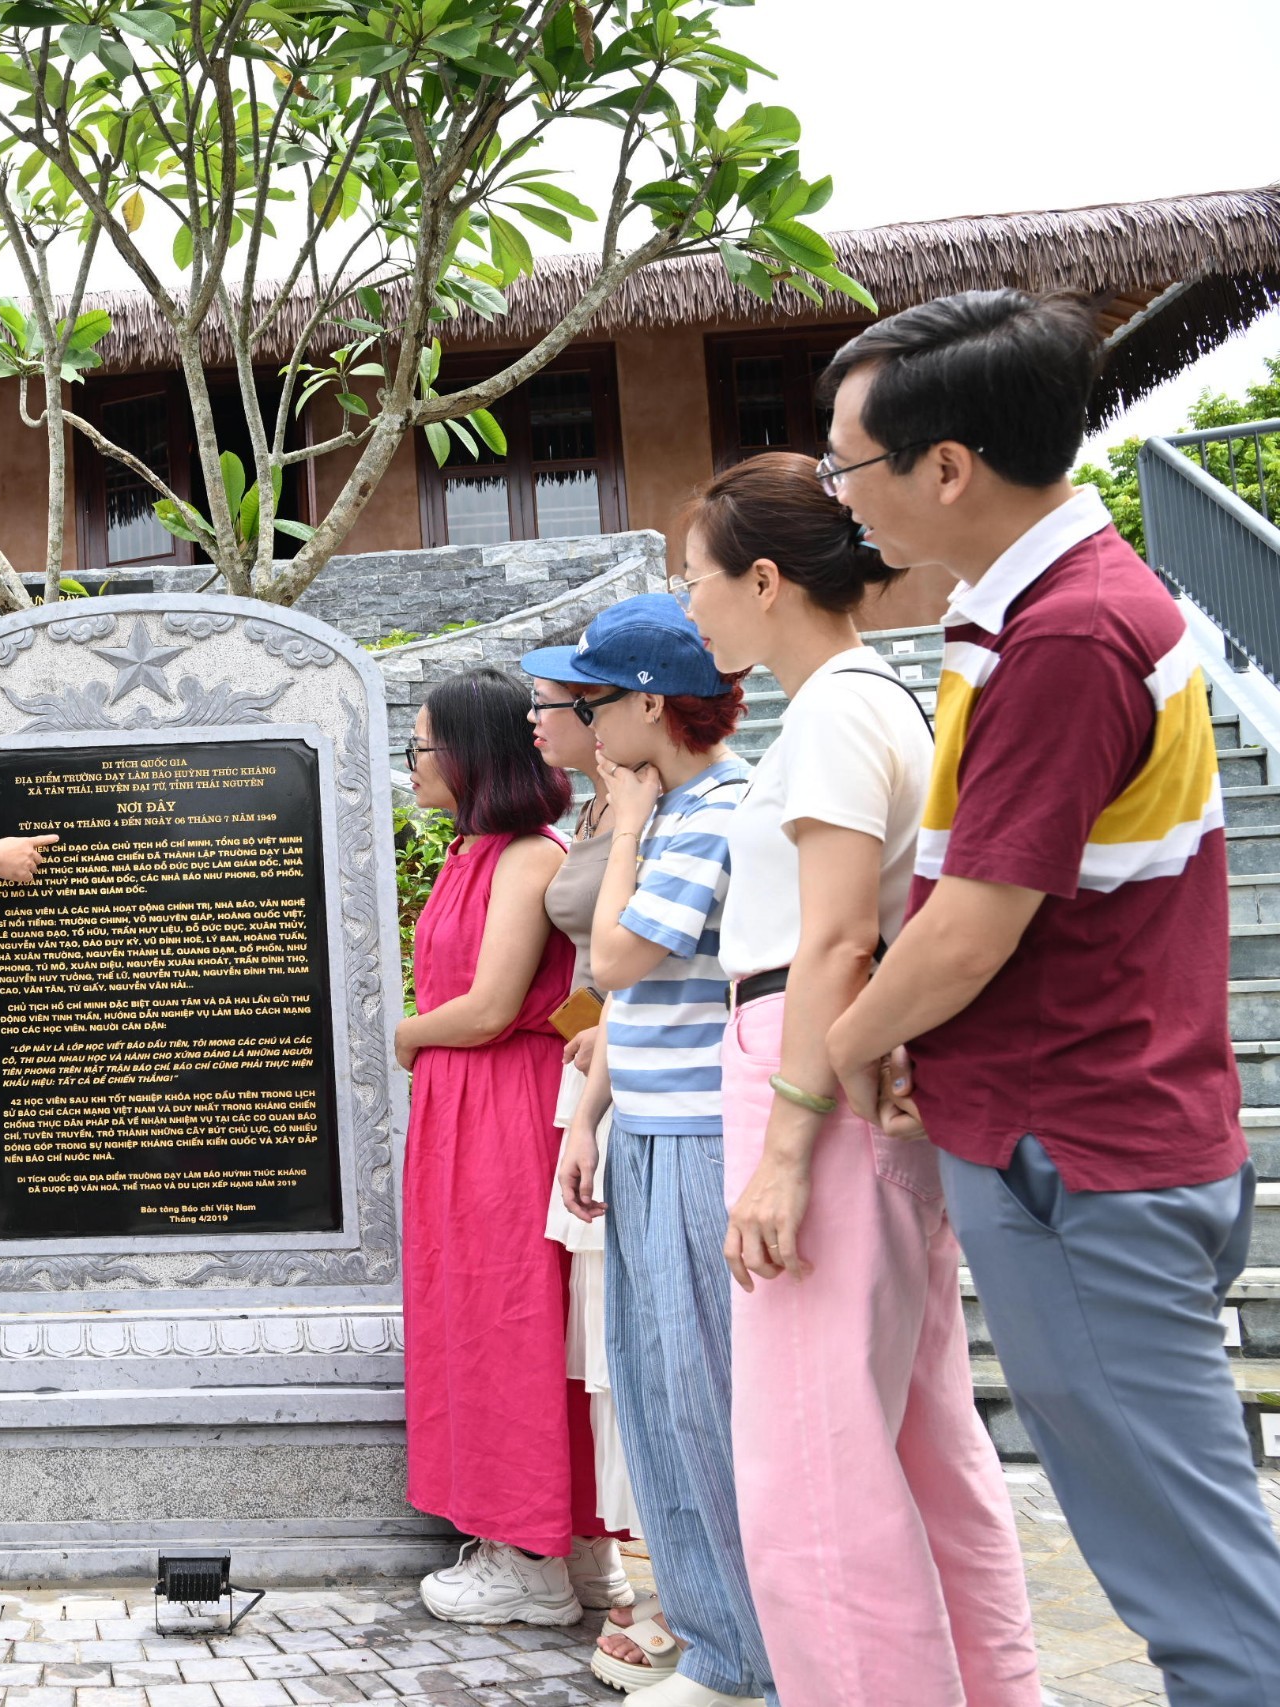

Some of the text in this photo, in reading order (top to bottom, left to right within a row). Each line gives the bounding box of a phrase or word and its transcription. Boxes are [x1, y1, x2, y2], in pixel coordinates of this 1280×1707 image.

[102, 761, 112, 769] DI
[114, 758, 138, 768] TÍCH
[169, 758, 187, 766] GIA
[104, 772, 125, 782] DẠY
[128, 770, 149, 780] LÀM
[152, 771, 172, 779] BÁO
[174, 768, 209, 778] HUỲNH
[212, 766, 238, 776] THÚC
[240, 765, 276, 775] KHÁNG
[44, 784, 64, 795] TÂN
[196, 779, 219, 788] THÁI
[222, 777, 264, 788] NGUYÊN
[33, 819, 61, 830] NGÀY
[76, 817, 111, 828] THÁNG
[144, 815, 172, 825] NGÀY
[187, 813, 222, 824] THÁNG
[257, 813, 276, 821] 1949
[132, 842, 153, 852] TỊCH
[170, 839, 185, 847] CHÍ
[81, 846, 303, 862] KHÁNG THÀNH DẠY LÀM
[50, 865, 73, 874] THÚC
[191, 862, 210, 870] DỤC
[234, 859, 257, 867] GIÁM
[283, 857, 303, 865] NHÀ
[70, 872, 201, 884] PHÓ GIÁM CÁC BÁO
[56, 887, 76, 896] VIÊN
[100, 886, 123, 894] GIÁM
[35, 900, 234, 915] VIÊN NHÀ HOẠT CHÍNH NHÀ
[149, 911, 251, 922] NGUYÊN HOÀNG
[10, 921, 276, 938] QUANG HUY XUÂN
[244, 932, 276, 941] HOÀNG
[14, 951, 40, 960] XUÂN
[127, 947, 158, 956] THÀNH
[176, 947, 210, 955] QUANG
[70, 957, 195, 970] XUÂN XUÂN
[39, 974, 58, 982] HUY
[28, 1003, 48, 1012] TỊCH
[84, 1001, 107, 1009] MINH
[181, 997, 201, 1005] TÂM
[28, 1013, 49, 1022] VIÊN
[212, 1007, 231, 1016] LÀM
[255, 1006, 280, 1015] CÁCH
[283, 1006, 311, 1015] MẠNG
[22, 1025, 40, 1033] CÁC
[43, 1025, 62, 1034] HỌC
[32, 1043, 52, 1052] NÀY
[85, 1043, 104, 1052] HỌC
[192, 1038, 207, 1047] TÔI
[258, 1036, 277, 1045] CHÚ
[19, 1056, 35, 1064] THI
[87, 1054, 107, 1063] HỌC
[2, 1061, 211, 1076] TIÊN PHONG TRÊN BÁO CHÍ
[164, 1092, 191, 1101] KHÓA
[237, 1090, 258, 1099] TIÊN
[260, 1090, 292, 1098] TRONG
[295, 1090, 315, 1099] LỊCH
[56, 1107, 81, 1115] CÁCH
[83, 1107, 110, 1116] MẠNG
[221, 1103, 252, 1111] TRONG
[254, 1101, 286, 1110] KHÁNG
[64, 1113, 295, 1127] DÂN PHÁP TẠI CÁC QUAN
[23, 1125, 226, 1139] TUYÊN THÀNH CÂY BÚT
[34, 1135, 295, 1150] GÓP TRONG KHÁNG XÂY
[25, 1153, 62, 1162] BÁO CHÍ
[28, 1174, 46, 1182] TÍCH
[164, 1172, 181, 1180] DẠY
[222, 1169, 251, 1177] HUỲNH
[253, 1169, 275, 1177] THÚC
[278, 1168, 306, 1176] KHÁNG
[230, 1181, 253, 1189] HẠNG
[159, 1205, 179, 1213] tàng
[169, 1214, 228, 1224] Tháng 4/2019
